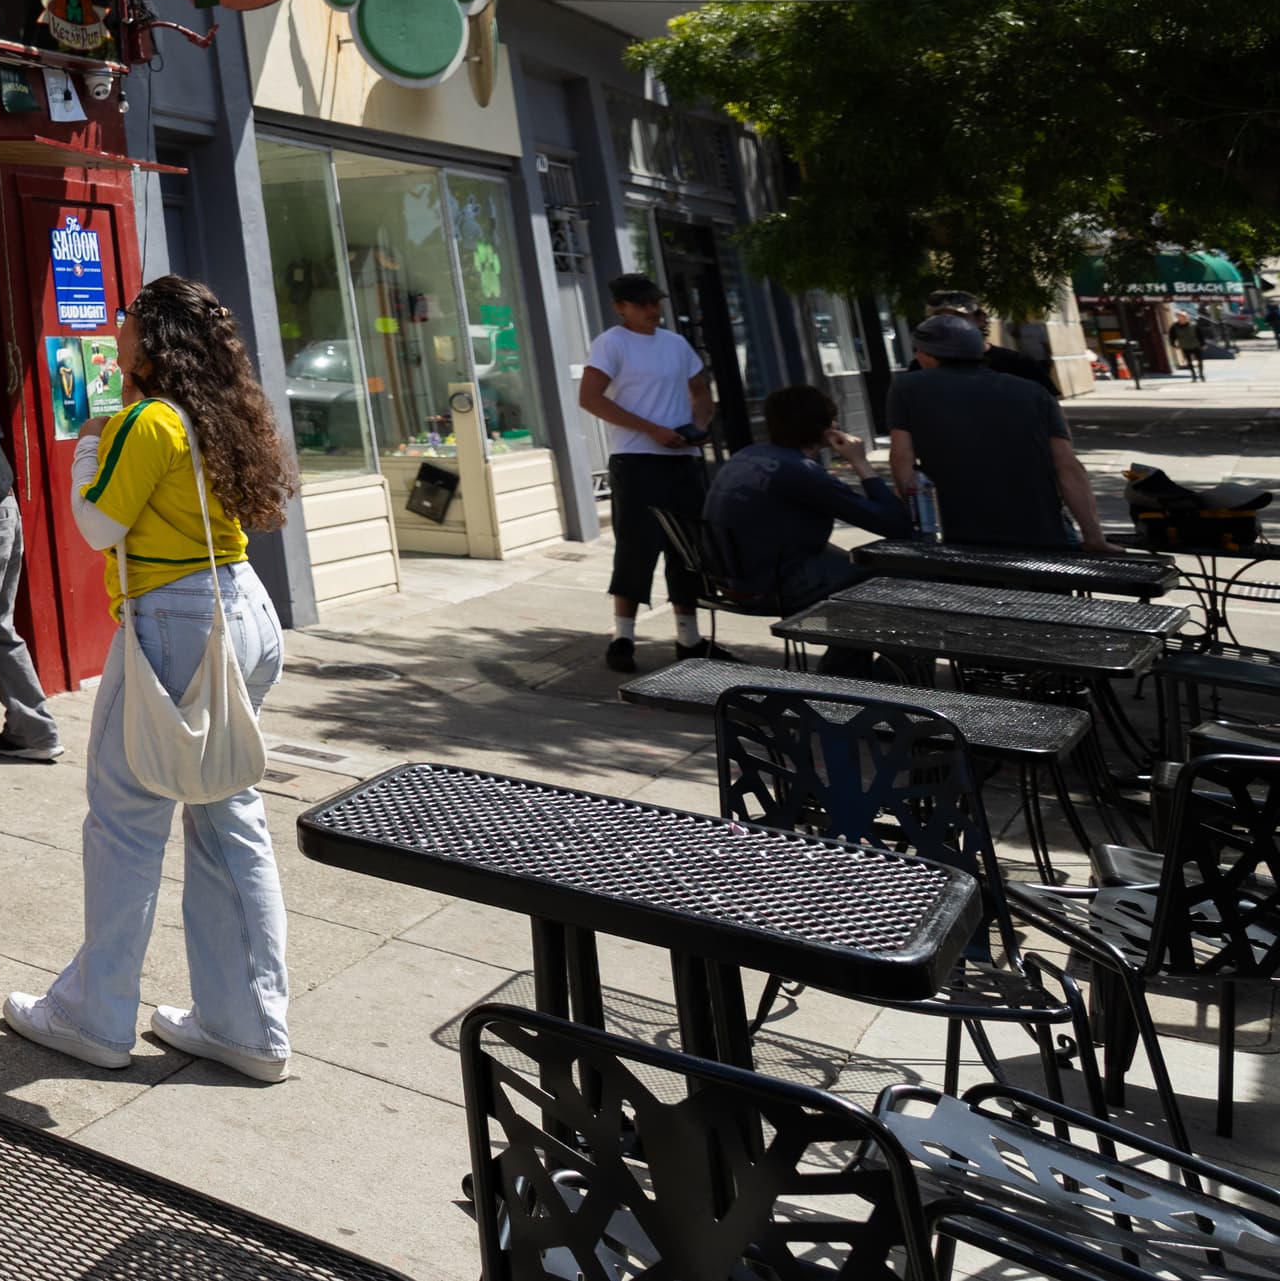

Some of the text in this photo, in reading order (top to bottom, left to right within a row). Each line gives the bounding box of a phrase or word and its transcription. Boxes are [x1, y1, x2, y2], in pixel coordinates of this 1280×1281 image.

[66, 216, 81, 234] The
[52, 229, 100, 263] SALOON
[1173, 281, 1223, 293] BEACH
[60, 304, 104, 319] BUD LIGHT
